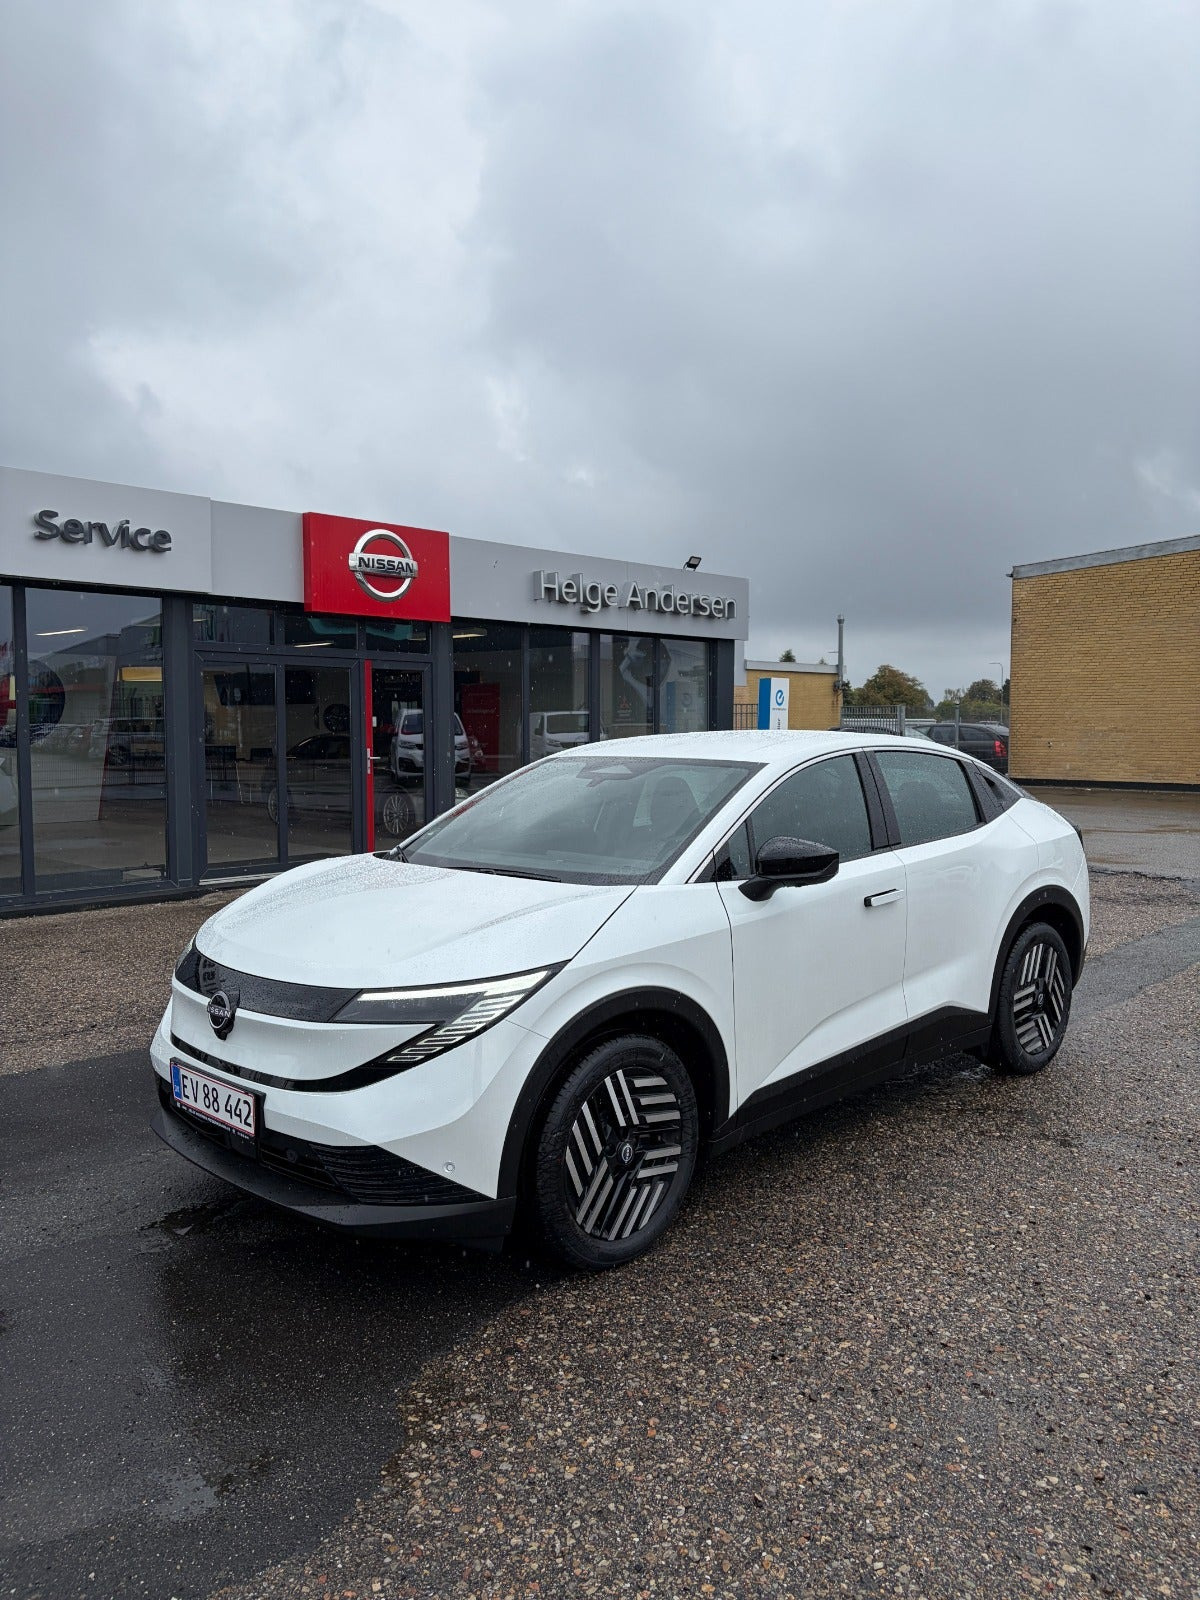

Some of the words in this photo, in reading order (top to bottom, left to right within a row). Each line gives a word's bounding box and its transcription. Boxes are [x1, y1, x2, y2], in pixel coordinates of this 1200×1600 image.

[34, 510, 172, 553] Service
[357, 556, 413, 574] NISSAN
[536, 570, 618, 613] Helge
[624, 580, 737, 619] Andersen
[207, 1004, 231, 1018] ISSAN
[181, 1074, 199, 1103] EV
[203, 1083, 220, 1113] 88
[225, 1094, 252, 1128] 442
